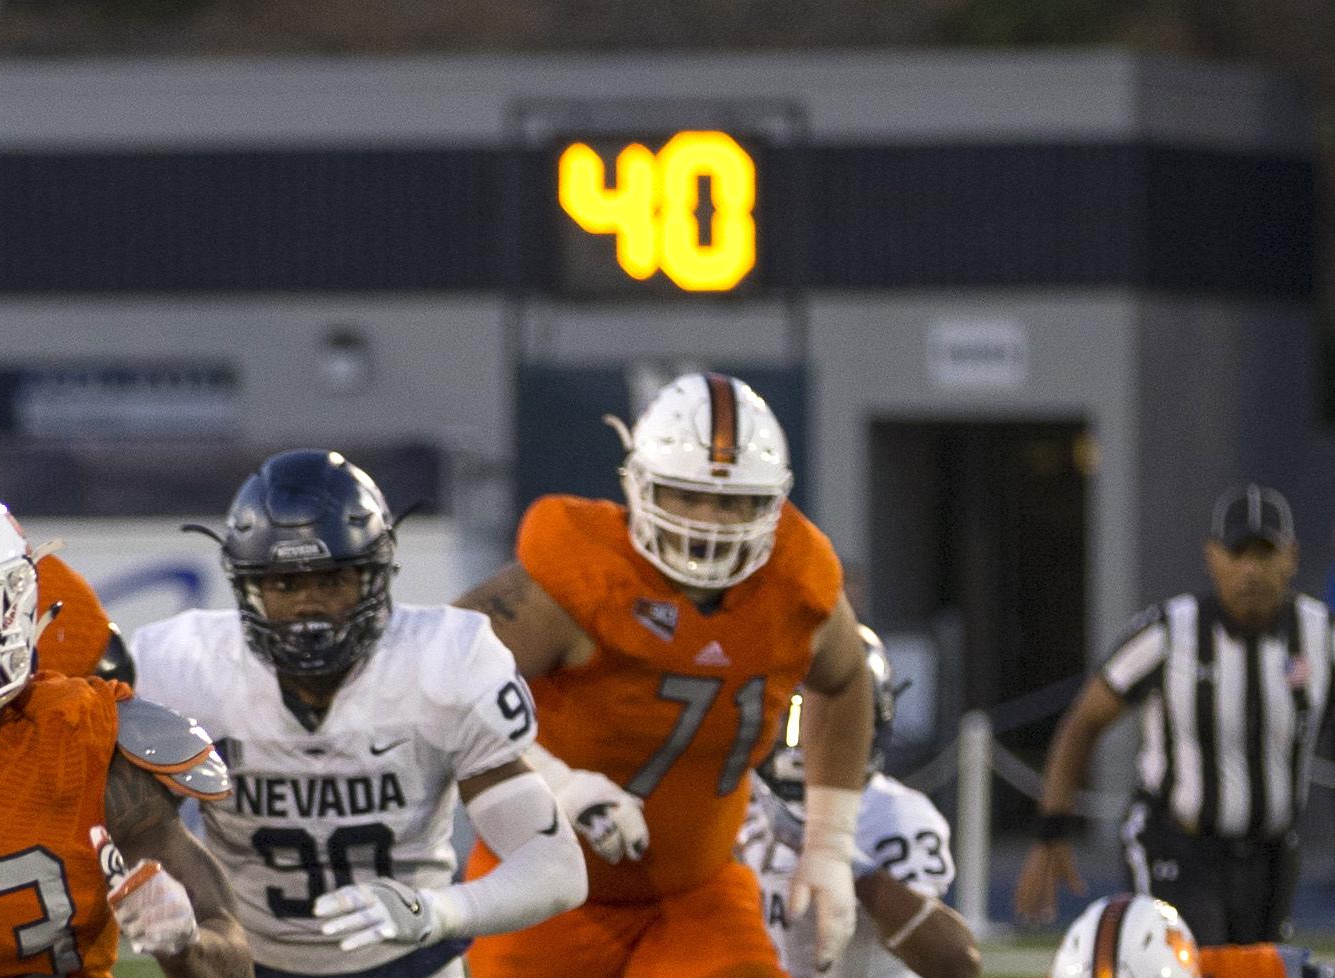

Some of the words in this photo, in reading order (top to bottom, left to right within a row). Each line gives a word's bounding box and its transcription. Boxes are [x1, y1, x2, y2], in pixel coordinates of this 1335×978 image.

[558, 129, 757, 293] 40
[627, 672, 765, 797] 71
[234, 772, 406, 817] NEVADA
[251, 822, 395, 918] 90
[875, 831, 947, 885] 23
